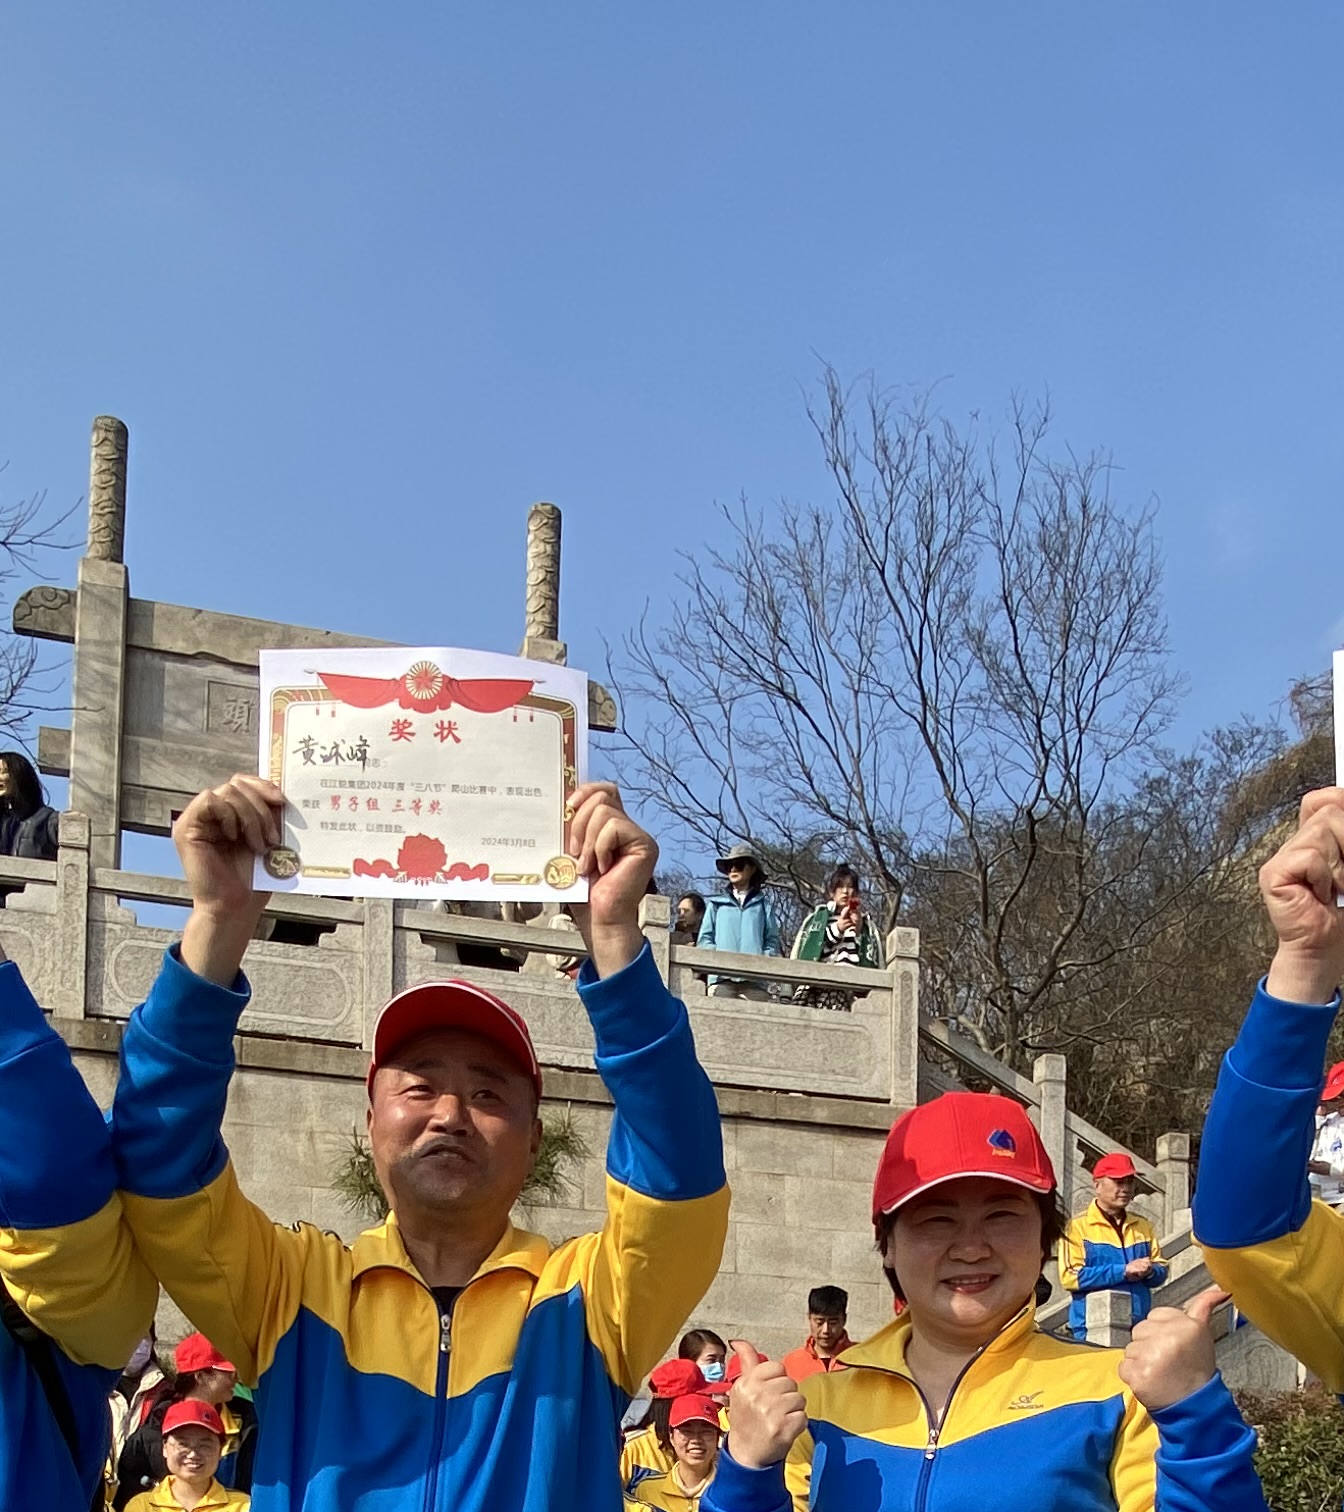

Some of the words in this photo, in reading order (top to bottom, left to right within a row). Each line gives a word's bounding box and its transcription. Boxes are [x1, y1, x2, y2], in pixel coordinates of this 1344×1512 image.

[388, 718, 462, 744] 奖状
[392, 797, 443, 816] 三等奖
